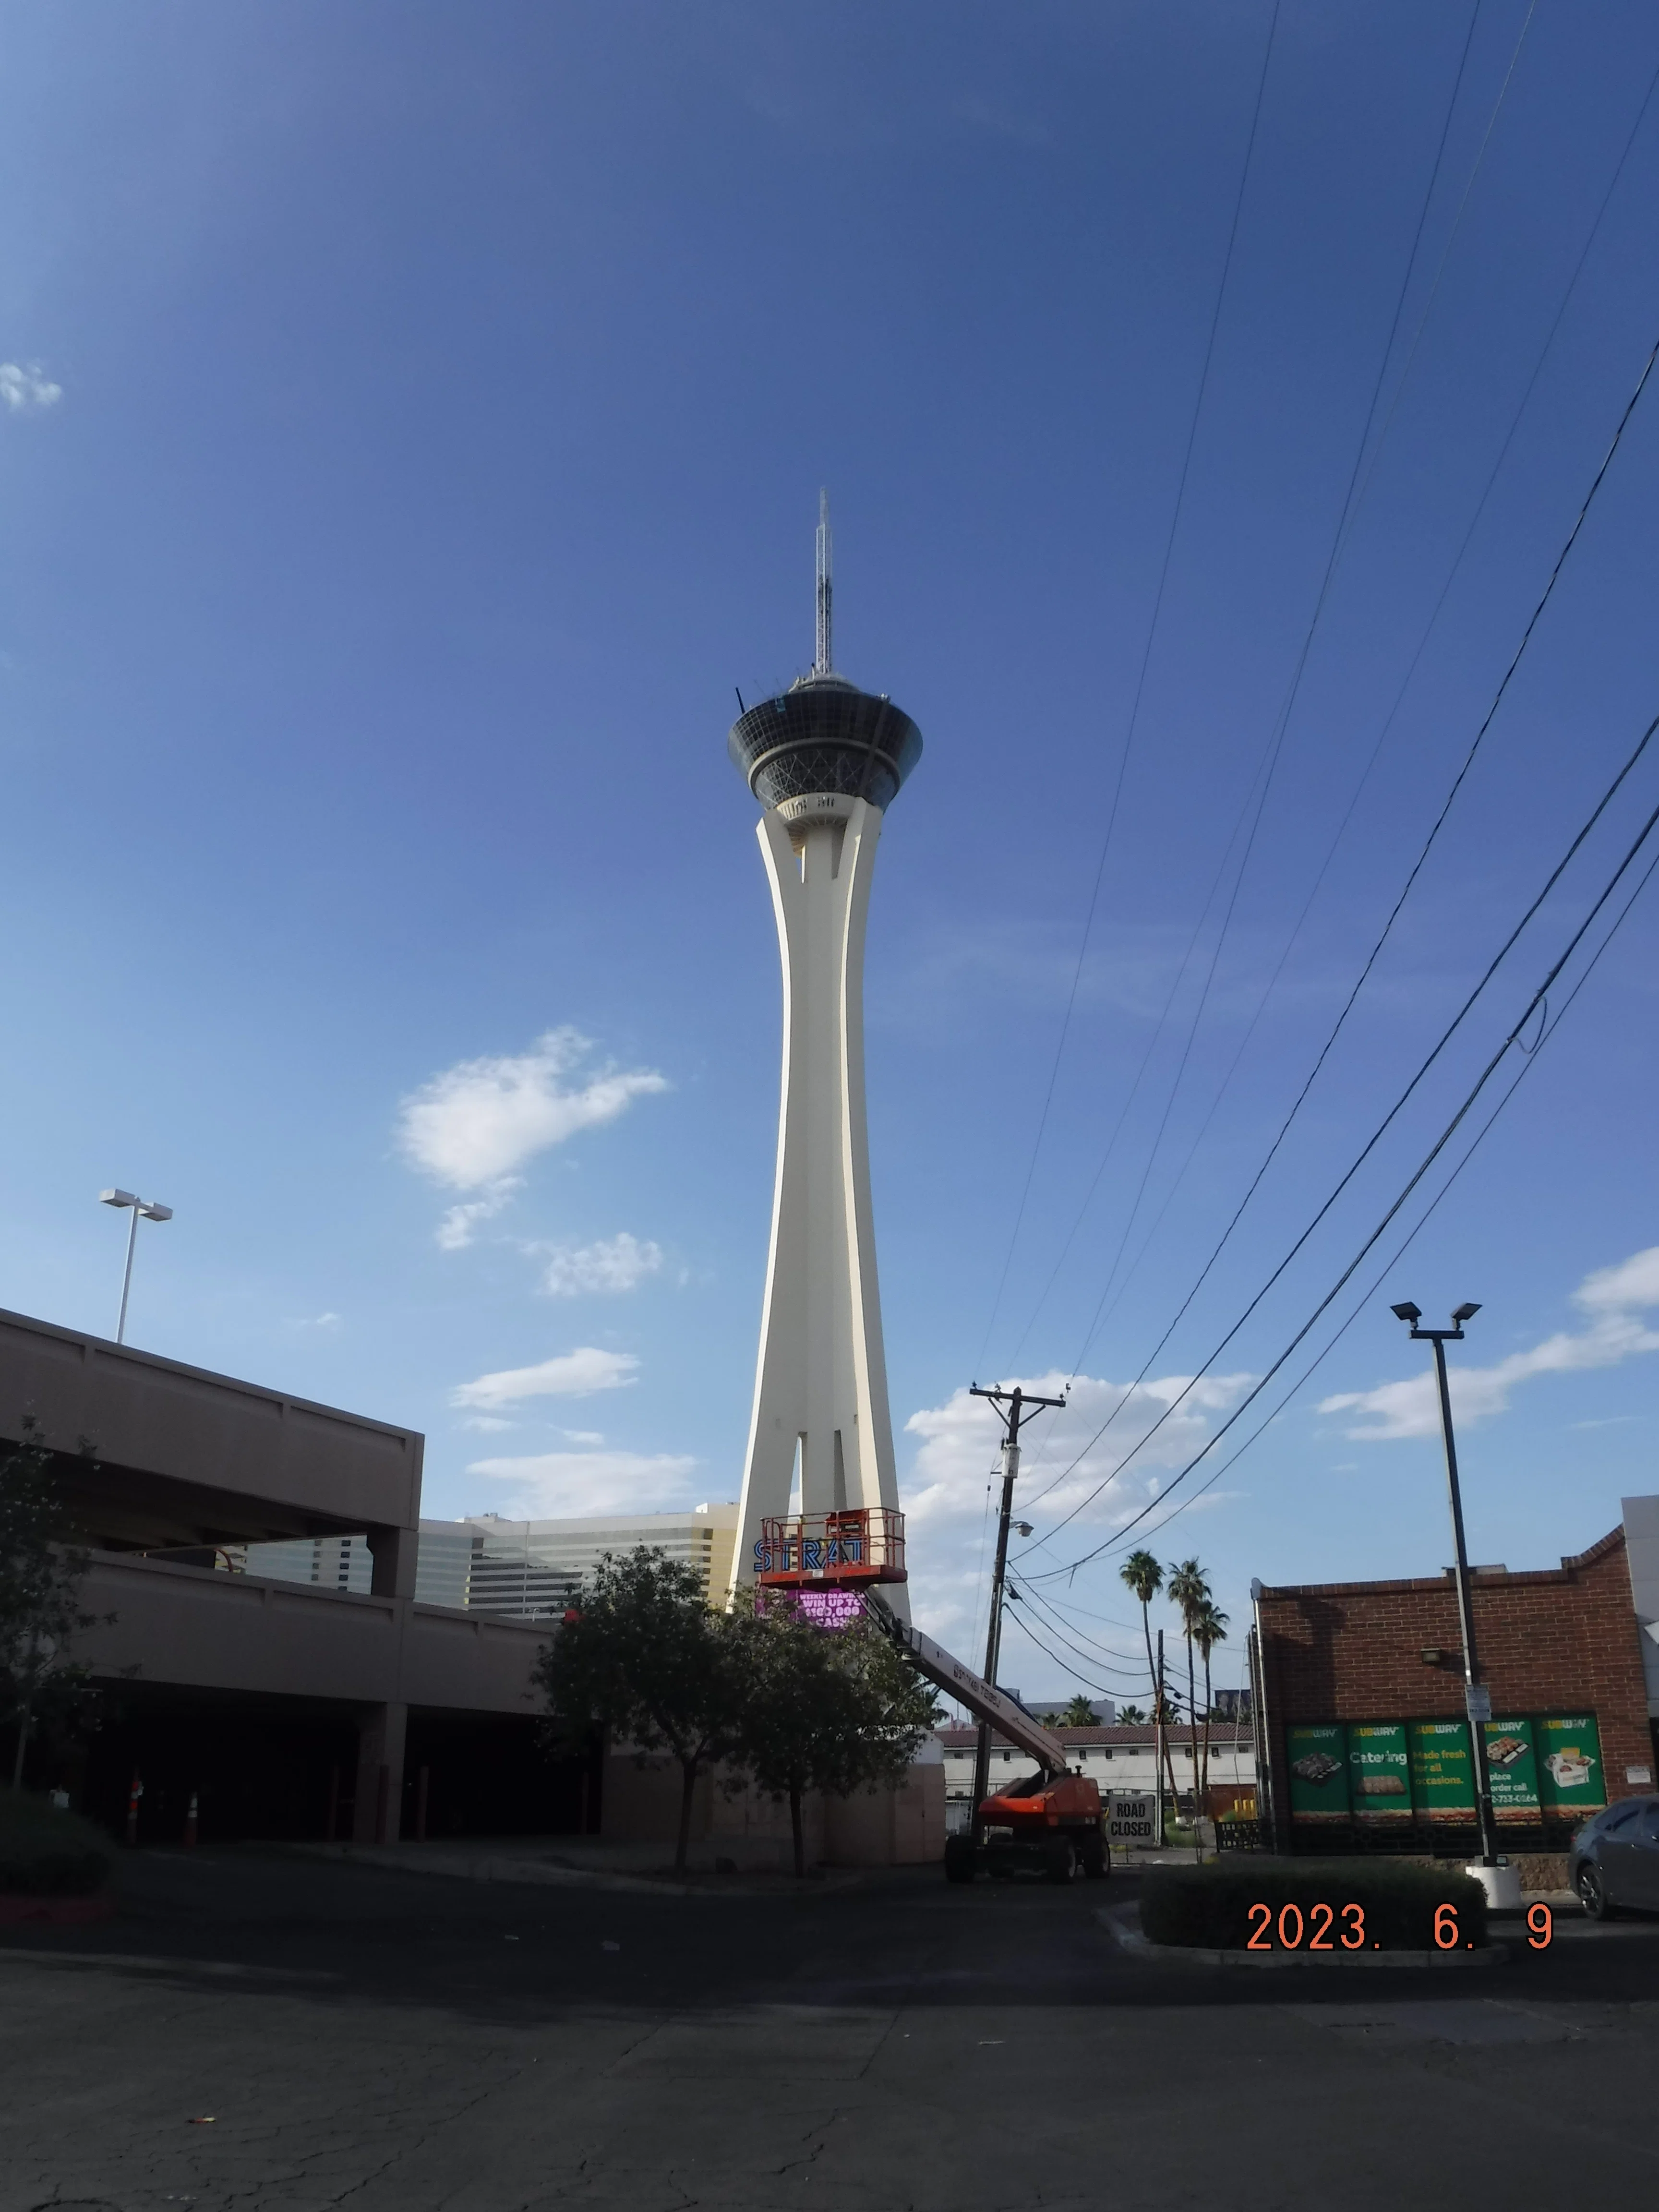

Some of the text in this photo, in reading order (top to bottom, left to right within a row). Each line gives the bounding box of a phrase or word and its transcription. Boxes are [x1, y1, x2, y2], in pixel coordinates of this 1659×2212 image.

[754, 1539, 866, 1572] STRAT
[802, 1599, 826, 1608] WIN
[1415, 1723, 1461, 1734] SUBWAY
[1484, 1721, 1525, 1731] UBWAY
[1541, 1719, 1589, 1729] SUBWAY
[1354, 1727, 1399, 1736] SUBWAY
[1350, 1750, 1407, 1766] Catering
[1413, 1749, 1466, 1759] Made fresh
[1430, 1763, 1442, 1772] all
[1416, 1776, 1464, 1785] occasions.
[1489, 1772, 1512, 1782] place
[1490, 1782, 1527, 1792] order call
[1117, 1803, 1146, 1817] ROAD
[1111, 1821, 1151, 1836] CLOSED
